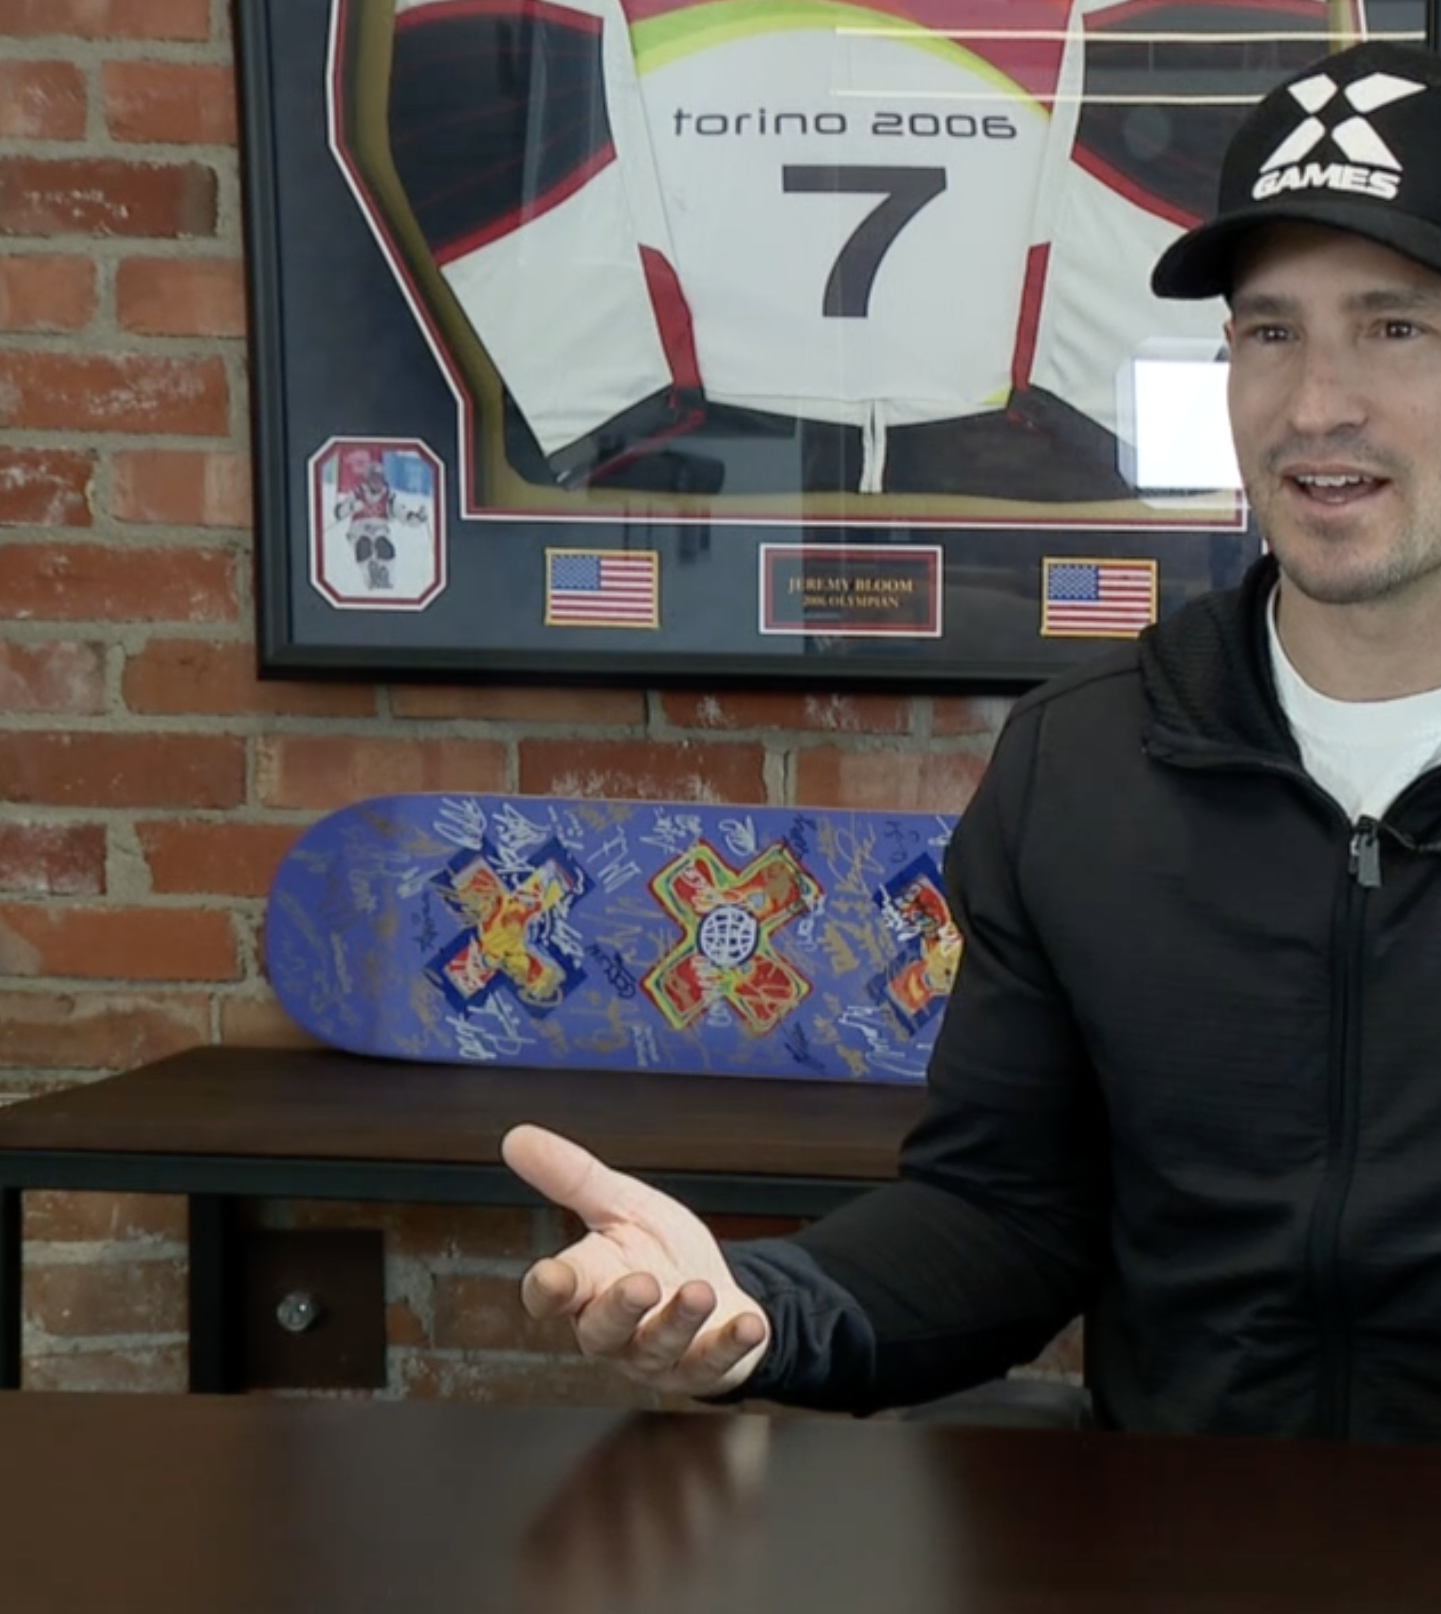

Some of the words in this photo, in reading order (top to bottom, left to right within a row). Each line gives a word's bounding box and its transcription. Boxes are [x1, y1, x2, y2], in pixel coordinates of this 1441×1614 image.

[673, 108, 847, 137] torino
[872, 112, 1017, 140] 2006
[1252, 162, 1401, 201] GAMES
[781, 164, 948, 319] 7
[788, 577, 849, 594] JEREMY
[854, 578, 914, 592] BLOOM
